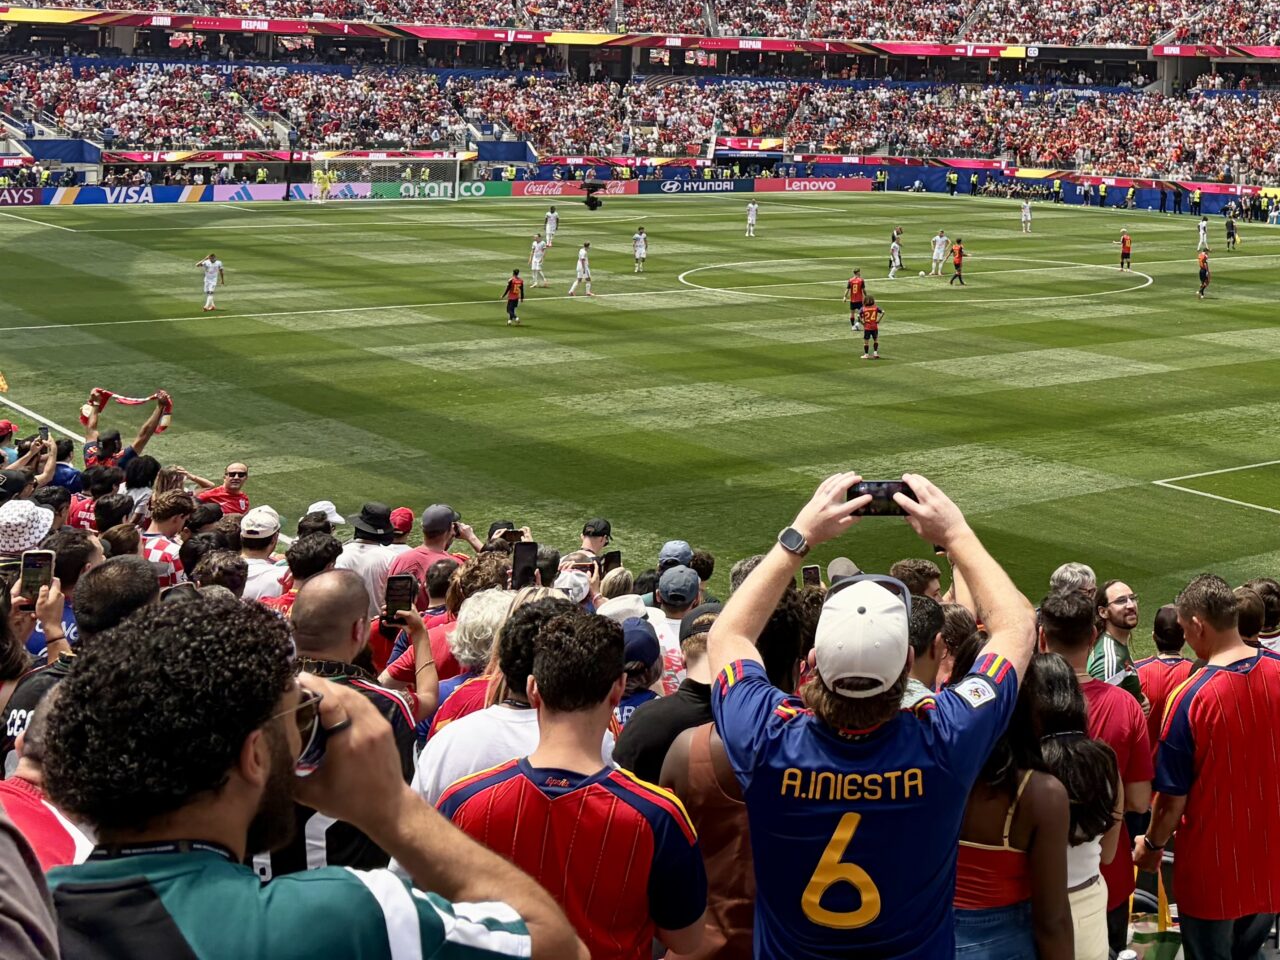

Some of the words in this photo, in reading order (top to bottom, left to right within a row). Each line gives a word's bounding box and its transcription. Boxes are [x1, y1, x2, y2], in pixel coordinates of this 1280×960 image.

[684, 181, 734, 191] HYUNDAI
[785, 180, 836, 191] Lenovo
[105, 187, 154, 203] VISA
[864, 310, 877, 323] 24
[780, 767, 923, 800] A.INIESTA
[801, 811, 882, 930] 6
